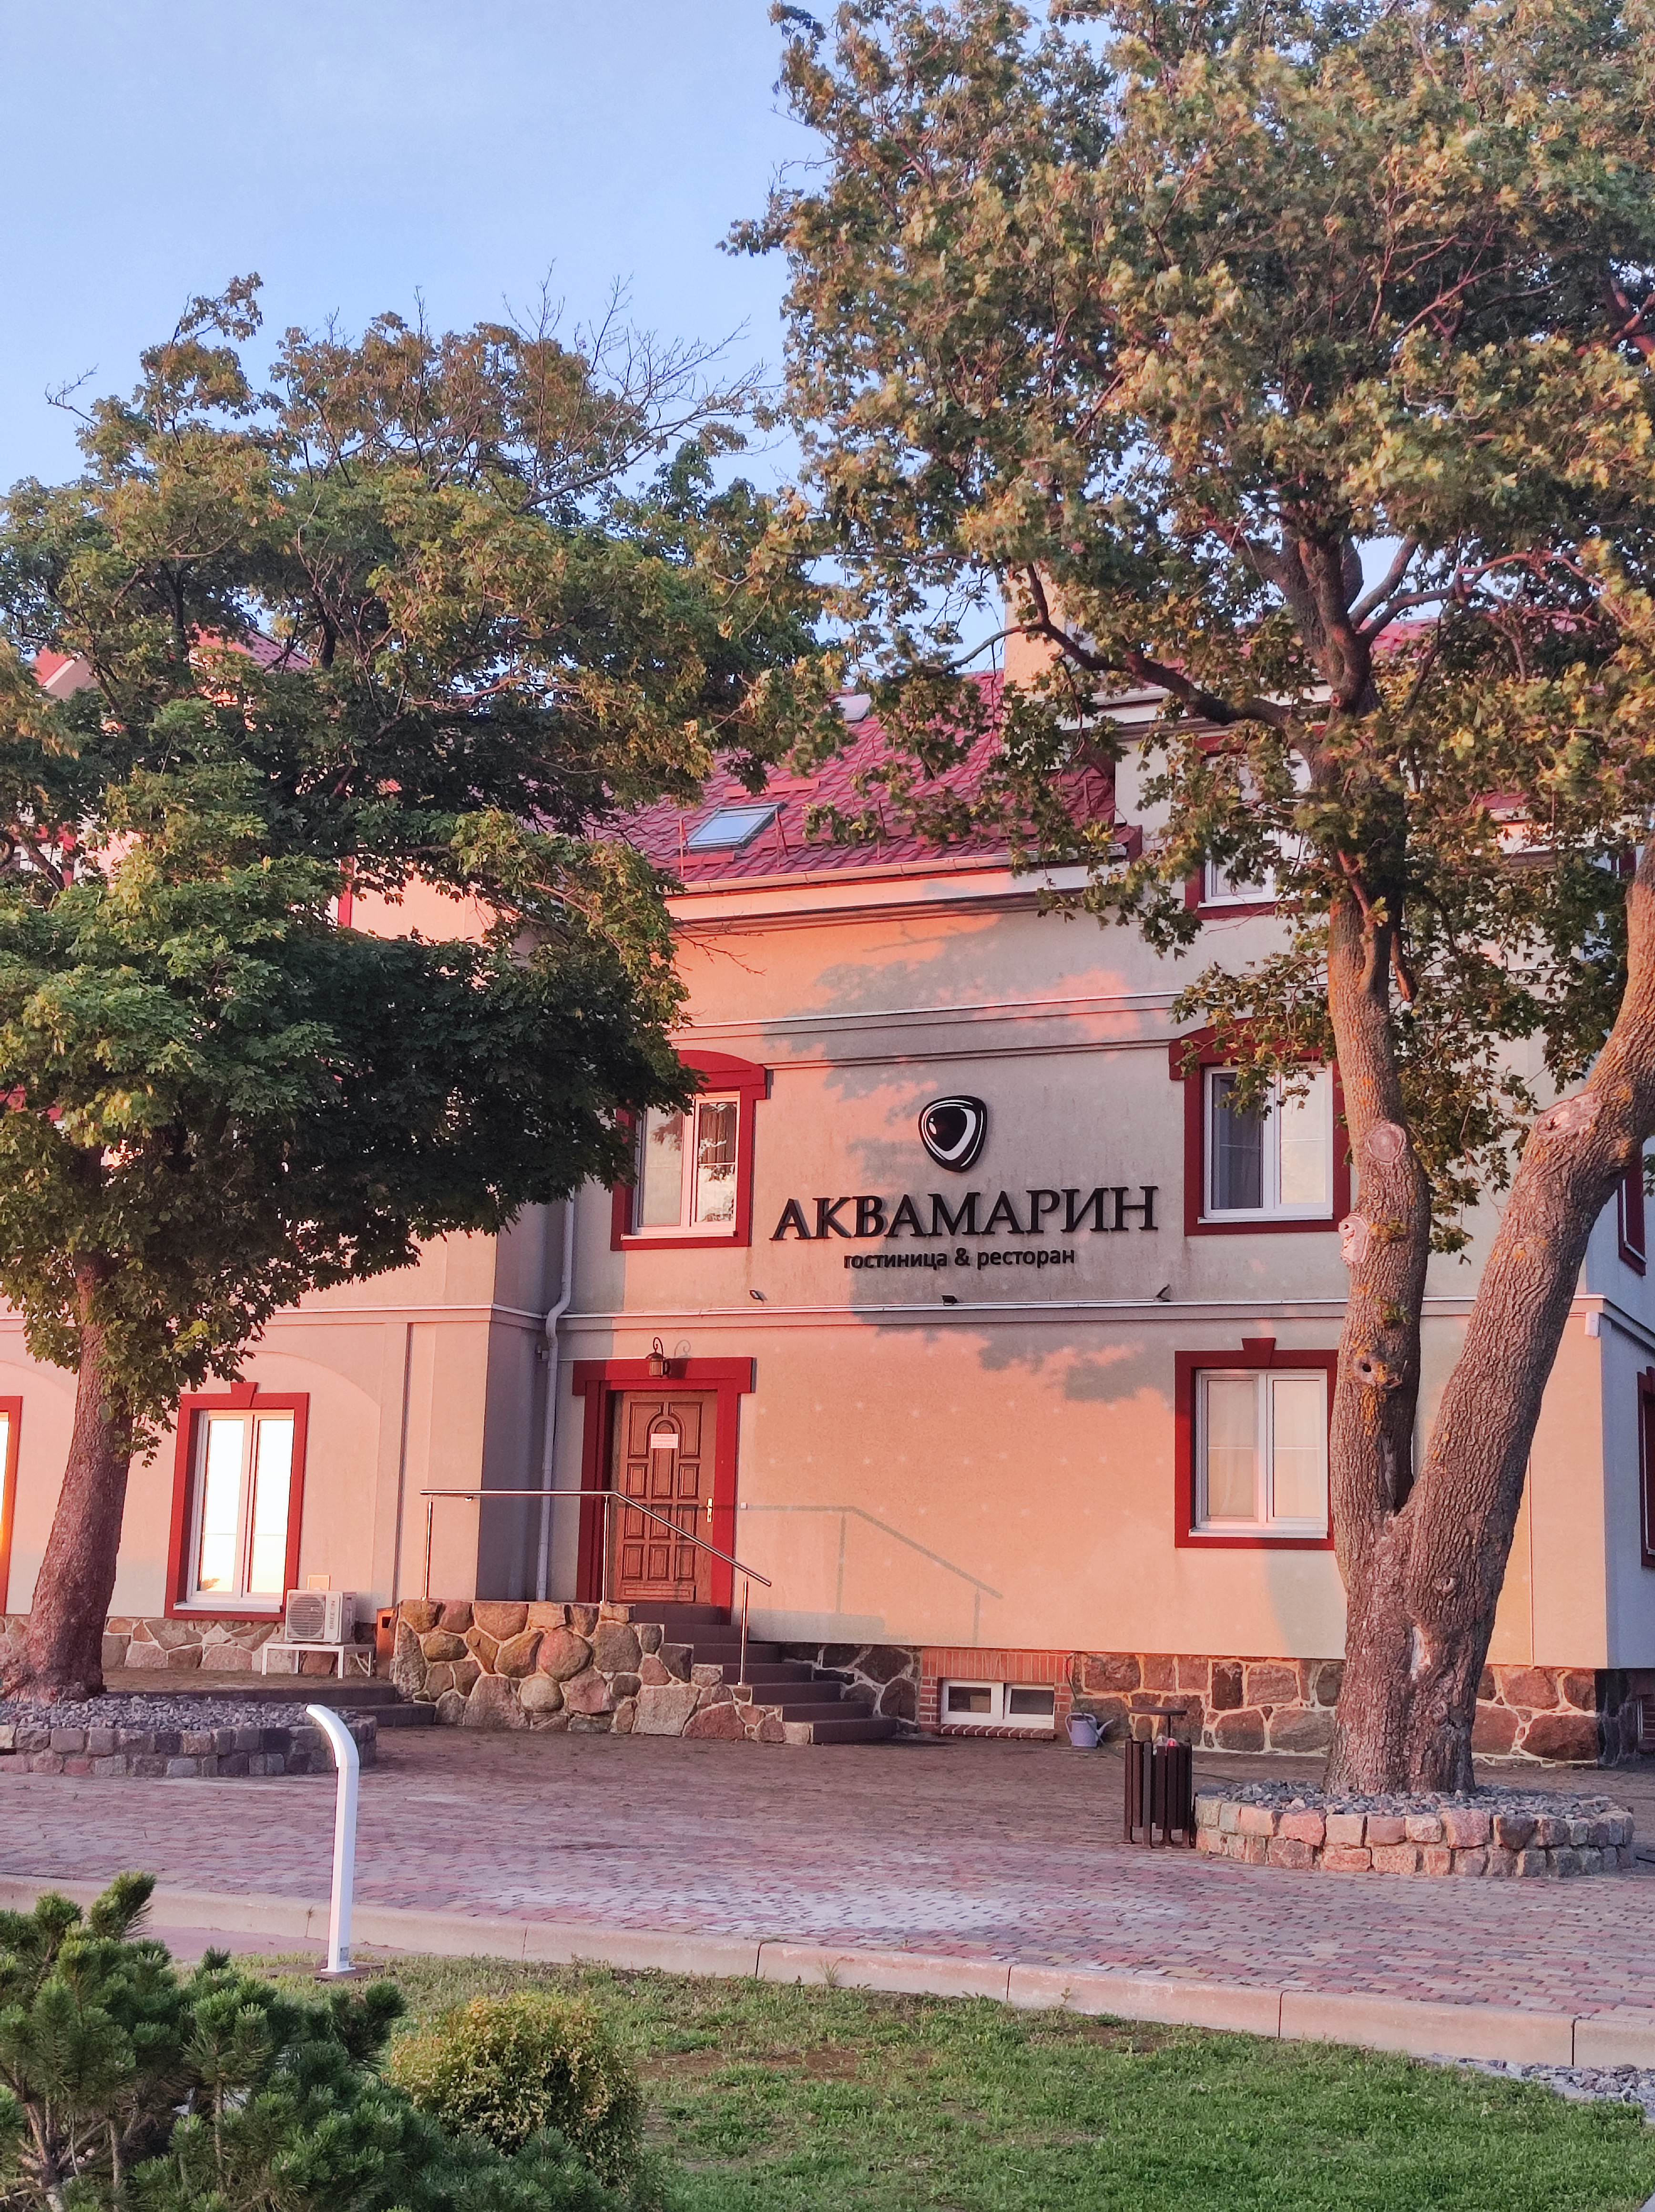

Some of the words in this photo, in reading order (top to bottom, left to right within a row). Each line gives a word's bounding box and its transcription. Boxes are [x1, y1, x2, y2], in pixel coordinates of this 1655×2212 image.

[770, 1186, 1159, 1240] АКВАМАРИН
[844, 1252, 947, 1270] гостиница
[954, 1248, 971, 1266] &
[977, 1249, 1074, 1270] ресторан
